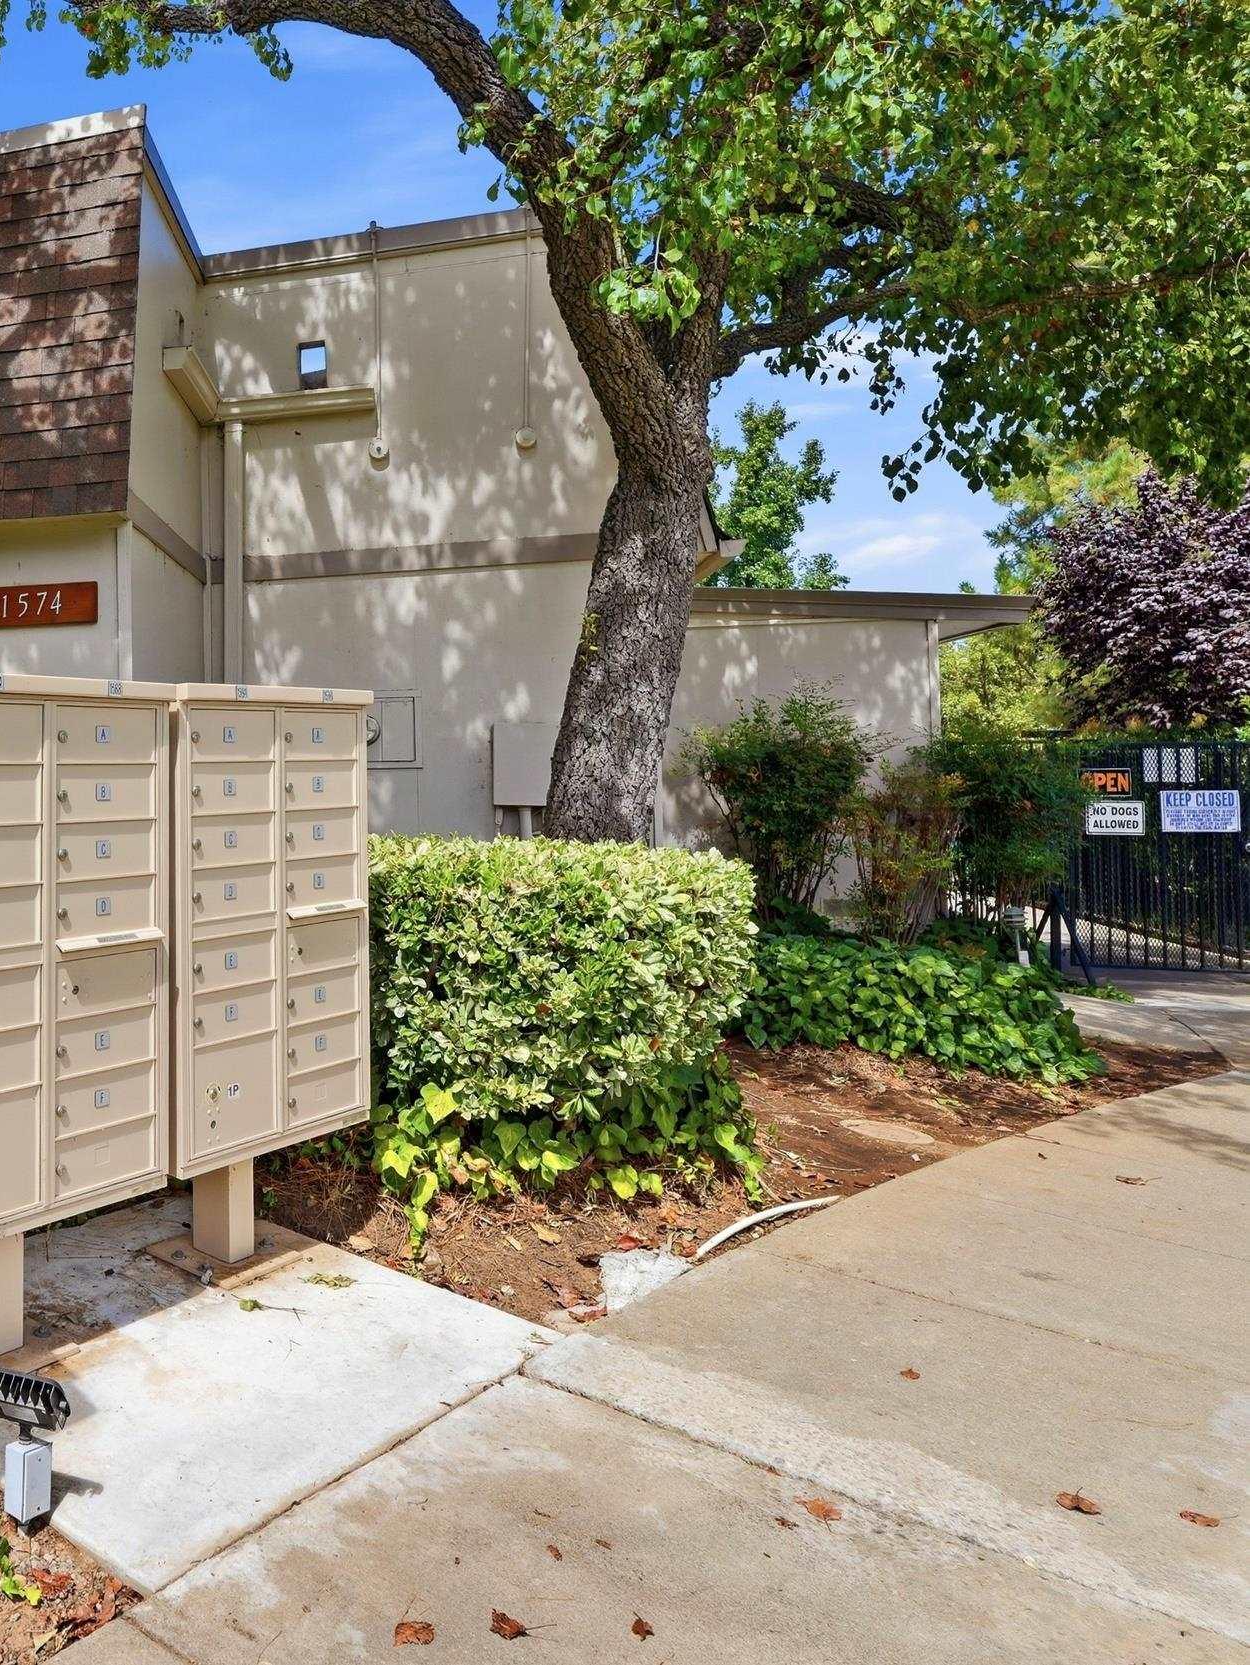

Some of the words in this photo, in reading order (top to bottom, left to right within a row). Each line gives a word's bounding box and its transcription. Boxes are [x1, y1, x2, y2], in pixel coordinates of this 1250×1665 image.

[2, 590, 62, 618] 1574
[100, 728, 106, 741] A
[1081, 772, 1129, 792] OPEN
[1165, 792, 1192, 807] KEEP
[1195, 792, 1235, 807] CLOSED
[1093, 806, 1107, 815] NO
[1111, 806, 1139, 816] DOGS
[1093, 819, 1139, 829] ALLOWED
[100, 843, 106, 856] C
[100, 1034, 105, 1046] E
[227, 1084, 239, 1097] 1P
[99, 1092, 106, 1103] F
